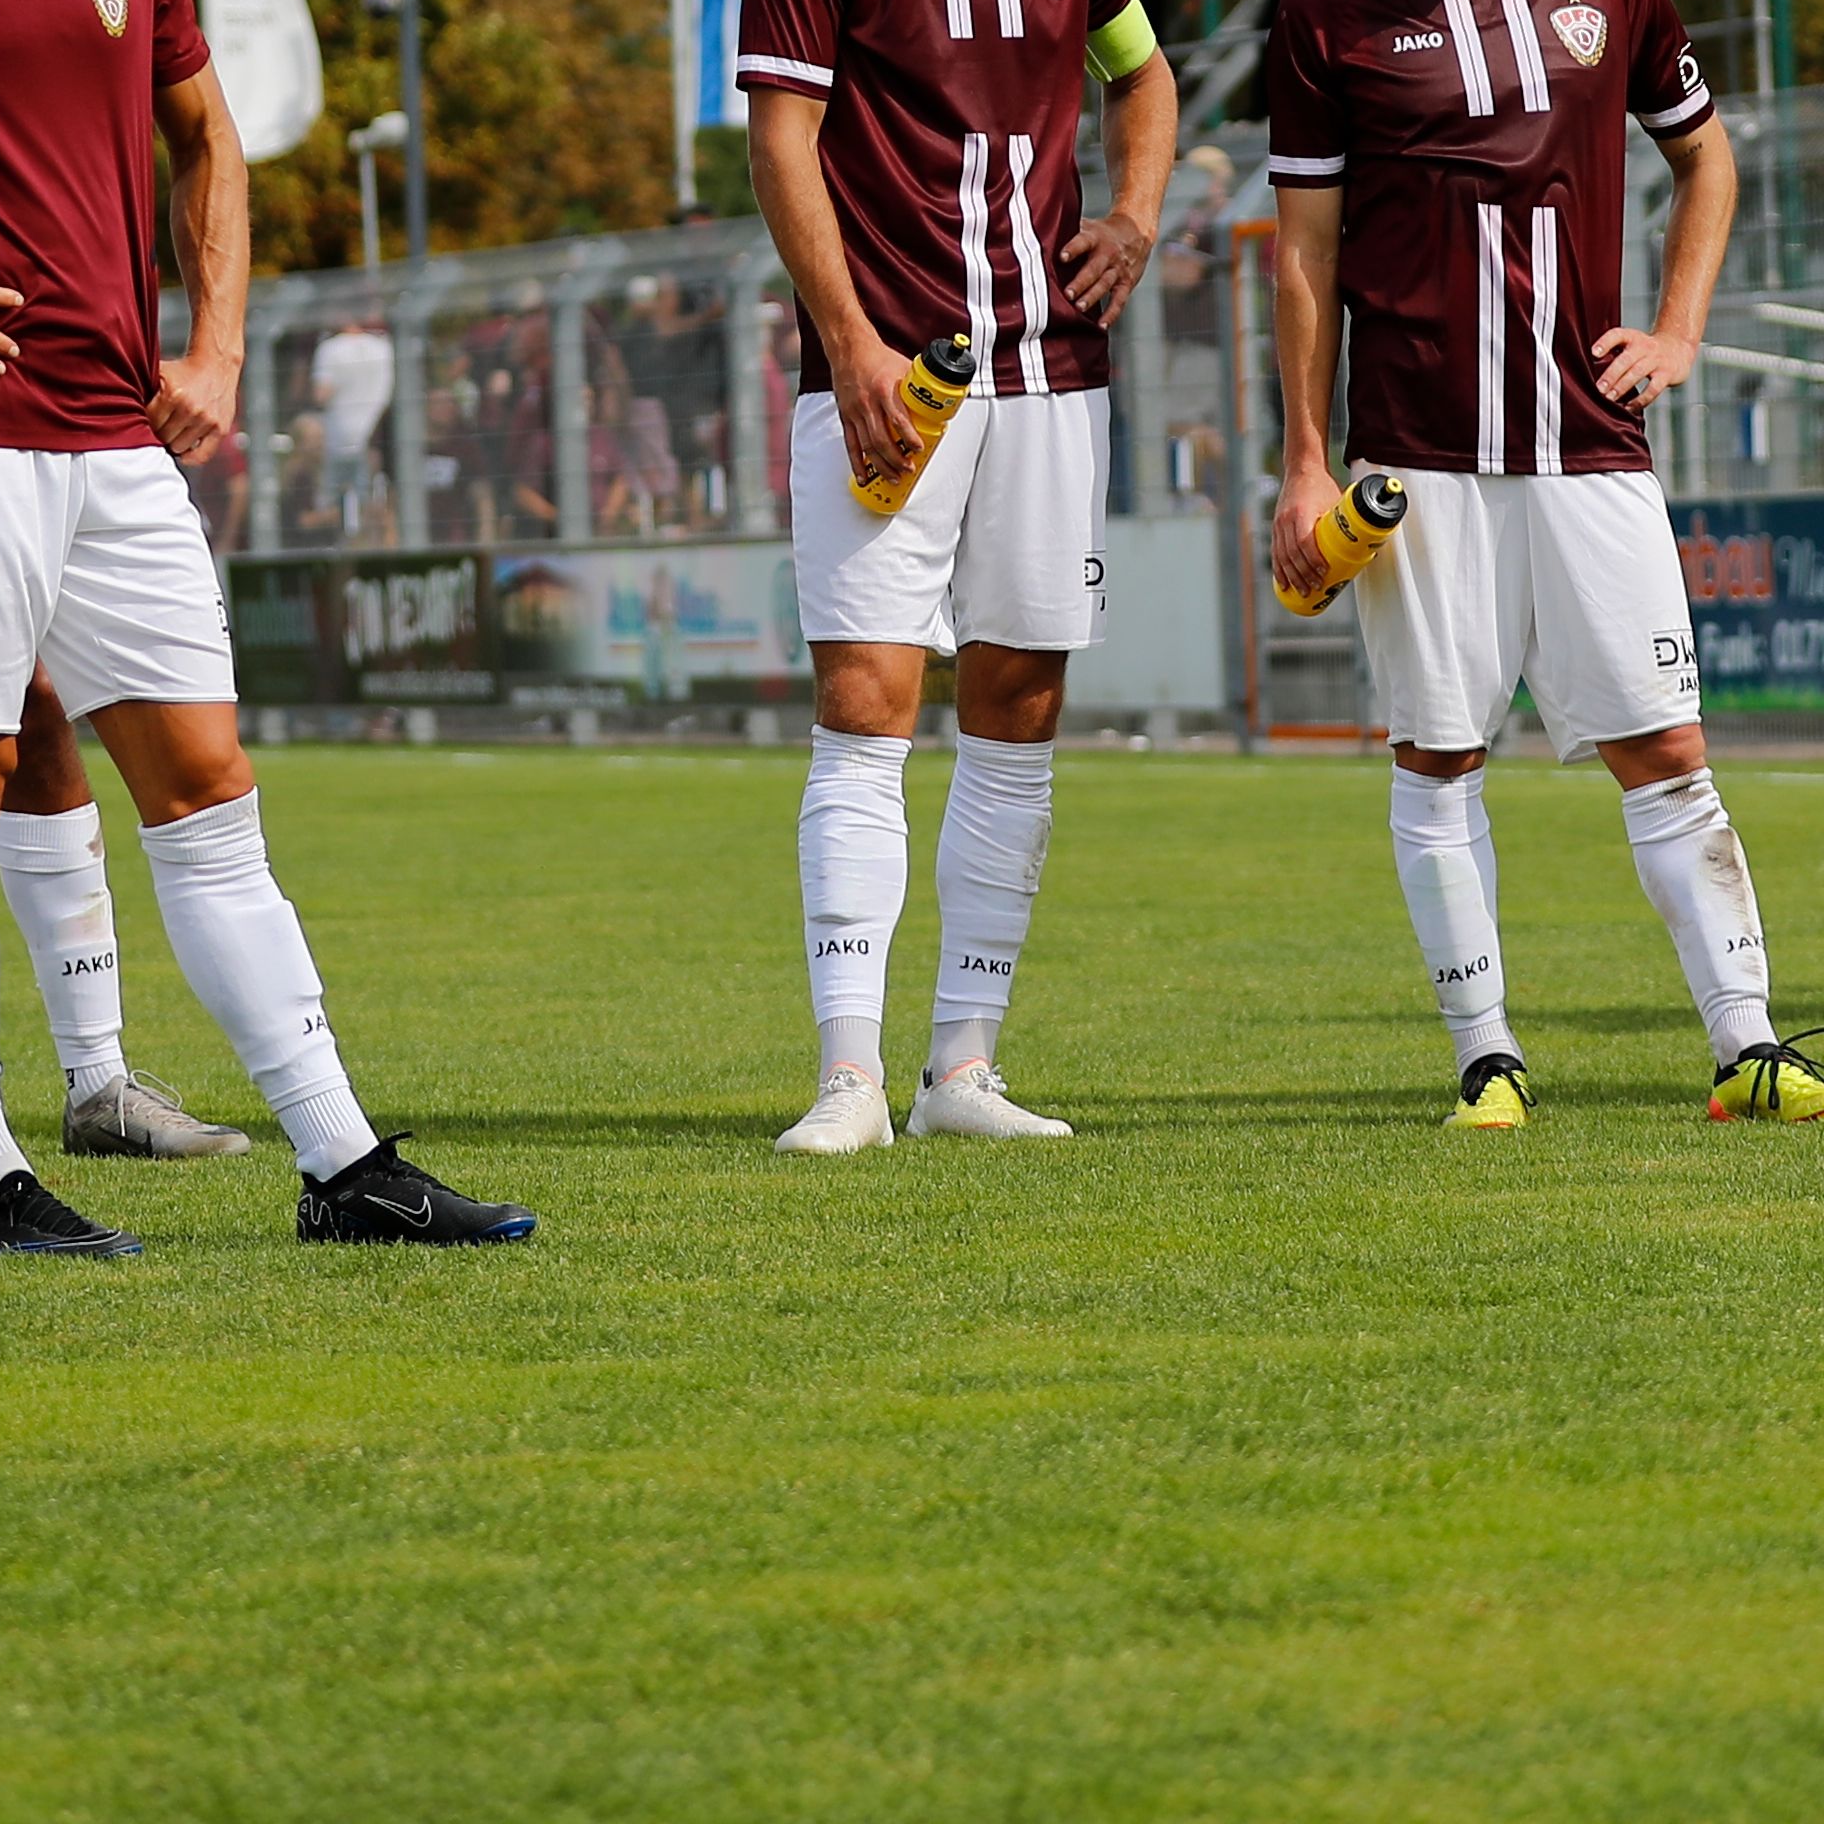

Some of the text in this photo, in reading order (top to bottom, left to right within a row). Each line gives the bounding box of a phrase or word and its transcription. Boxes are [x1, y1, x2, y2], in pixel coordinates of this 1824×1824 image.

[1557, 10, 1601, 27] BFC
[1392, 31, 1445, 54] JAKO
[814, 938, 871, 959] JAKO
[1727, 935, 1764, 953] JAK
[61, 951, 114, 976] JAKO
[959, 954, 1013, 977] JAKO
[1435, 955, 1490, 984] JAKO
